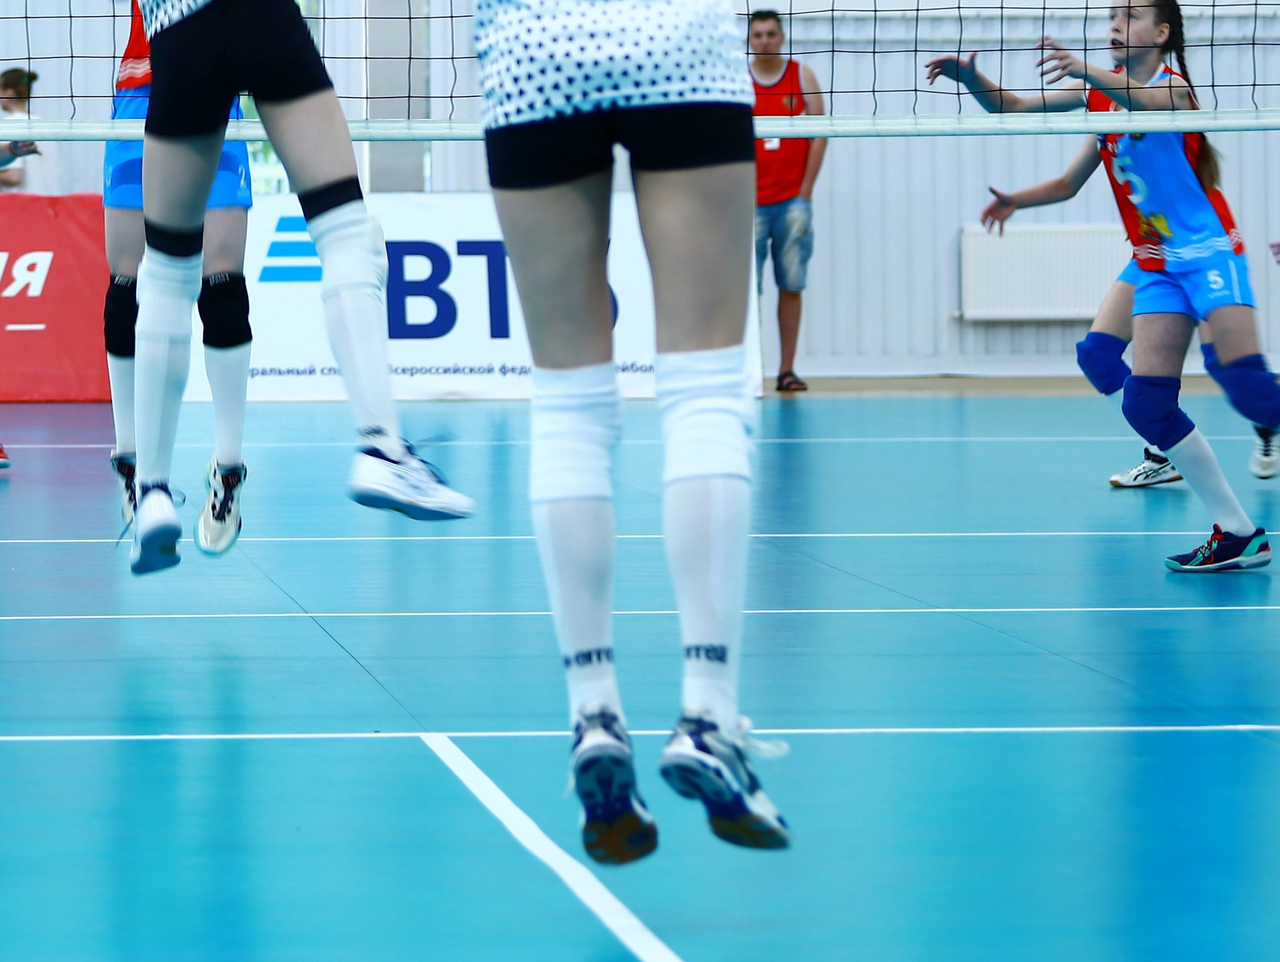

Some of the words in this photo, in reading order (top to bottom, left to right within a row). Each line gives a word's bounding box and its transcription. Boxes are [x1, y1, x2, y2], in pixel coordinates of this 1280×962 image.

[1112, 157, 1147, 203] 5
[385, 240, 619, 339] ВТ
[1207, 269, 1225, 290] 5
[249, 363, 317, 379] ральный
